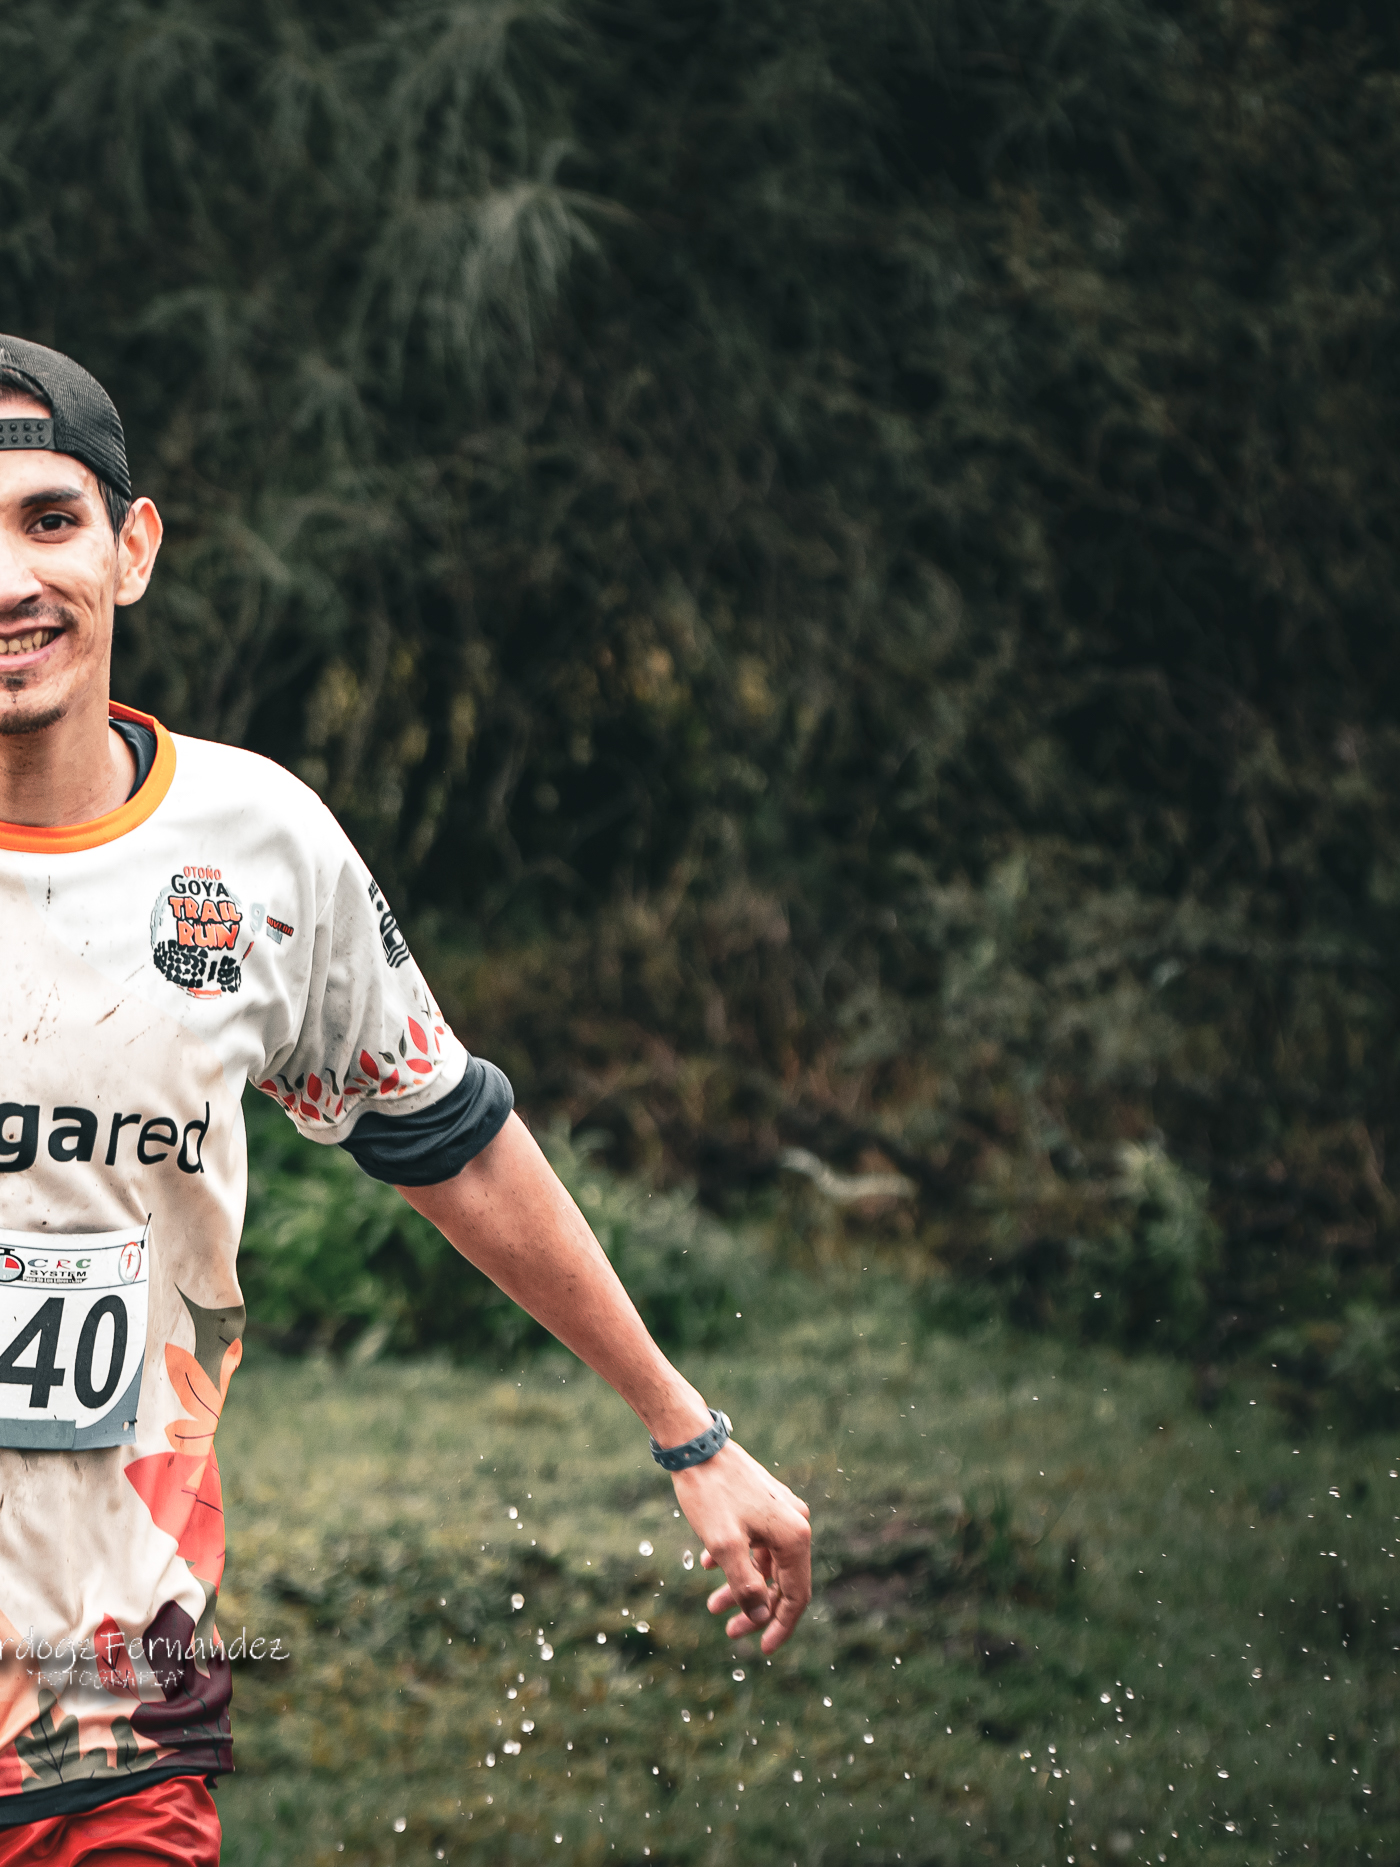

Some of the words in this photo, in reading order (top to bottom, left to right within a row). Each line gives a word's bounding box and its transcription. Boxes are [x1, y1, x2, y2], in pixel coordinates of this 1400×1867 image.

[171, 874, 230, 898] GOYA
[168, 895, 243, 923] TRAIL
[176, 919, 241, 951] RUN
[29, 1269, 87, 1278] SYSTEM
